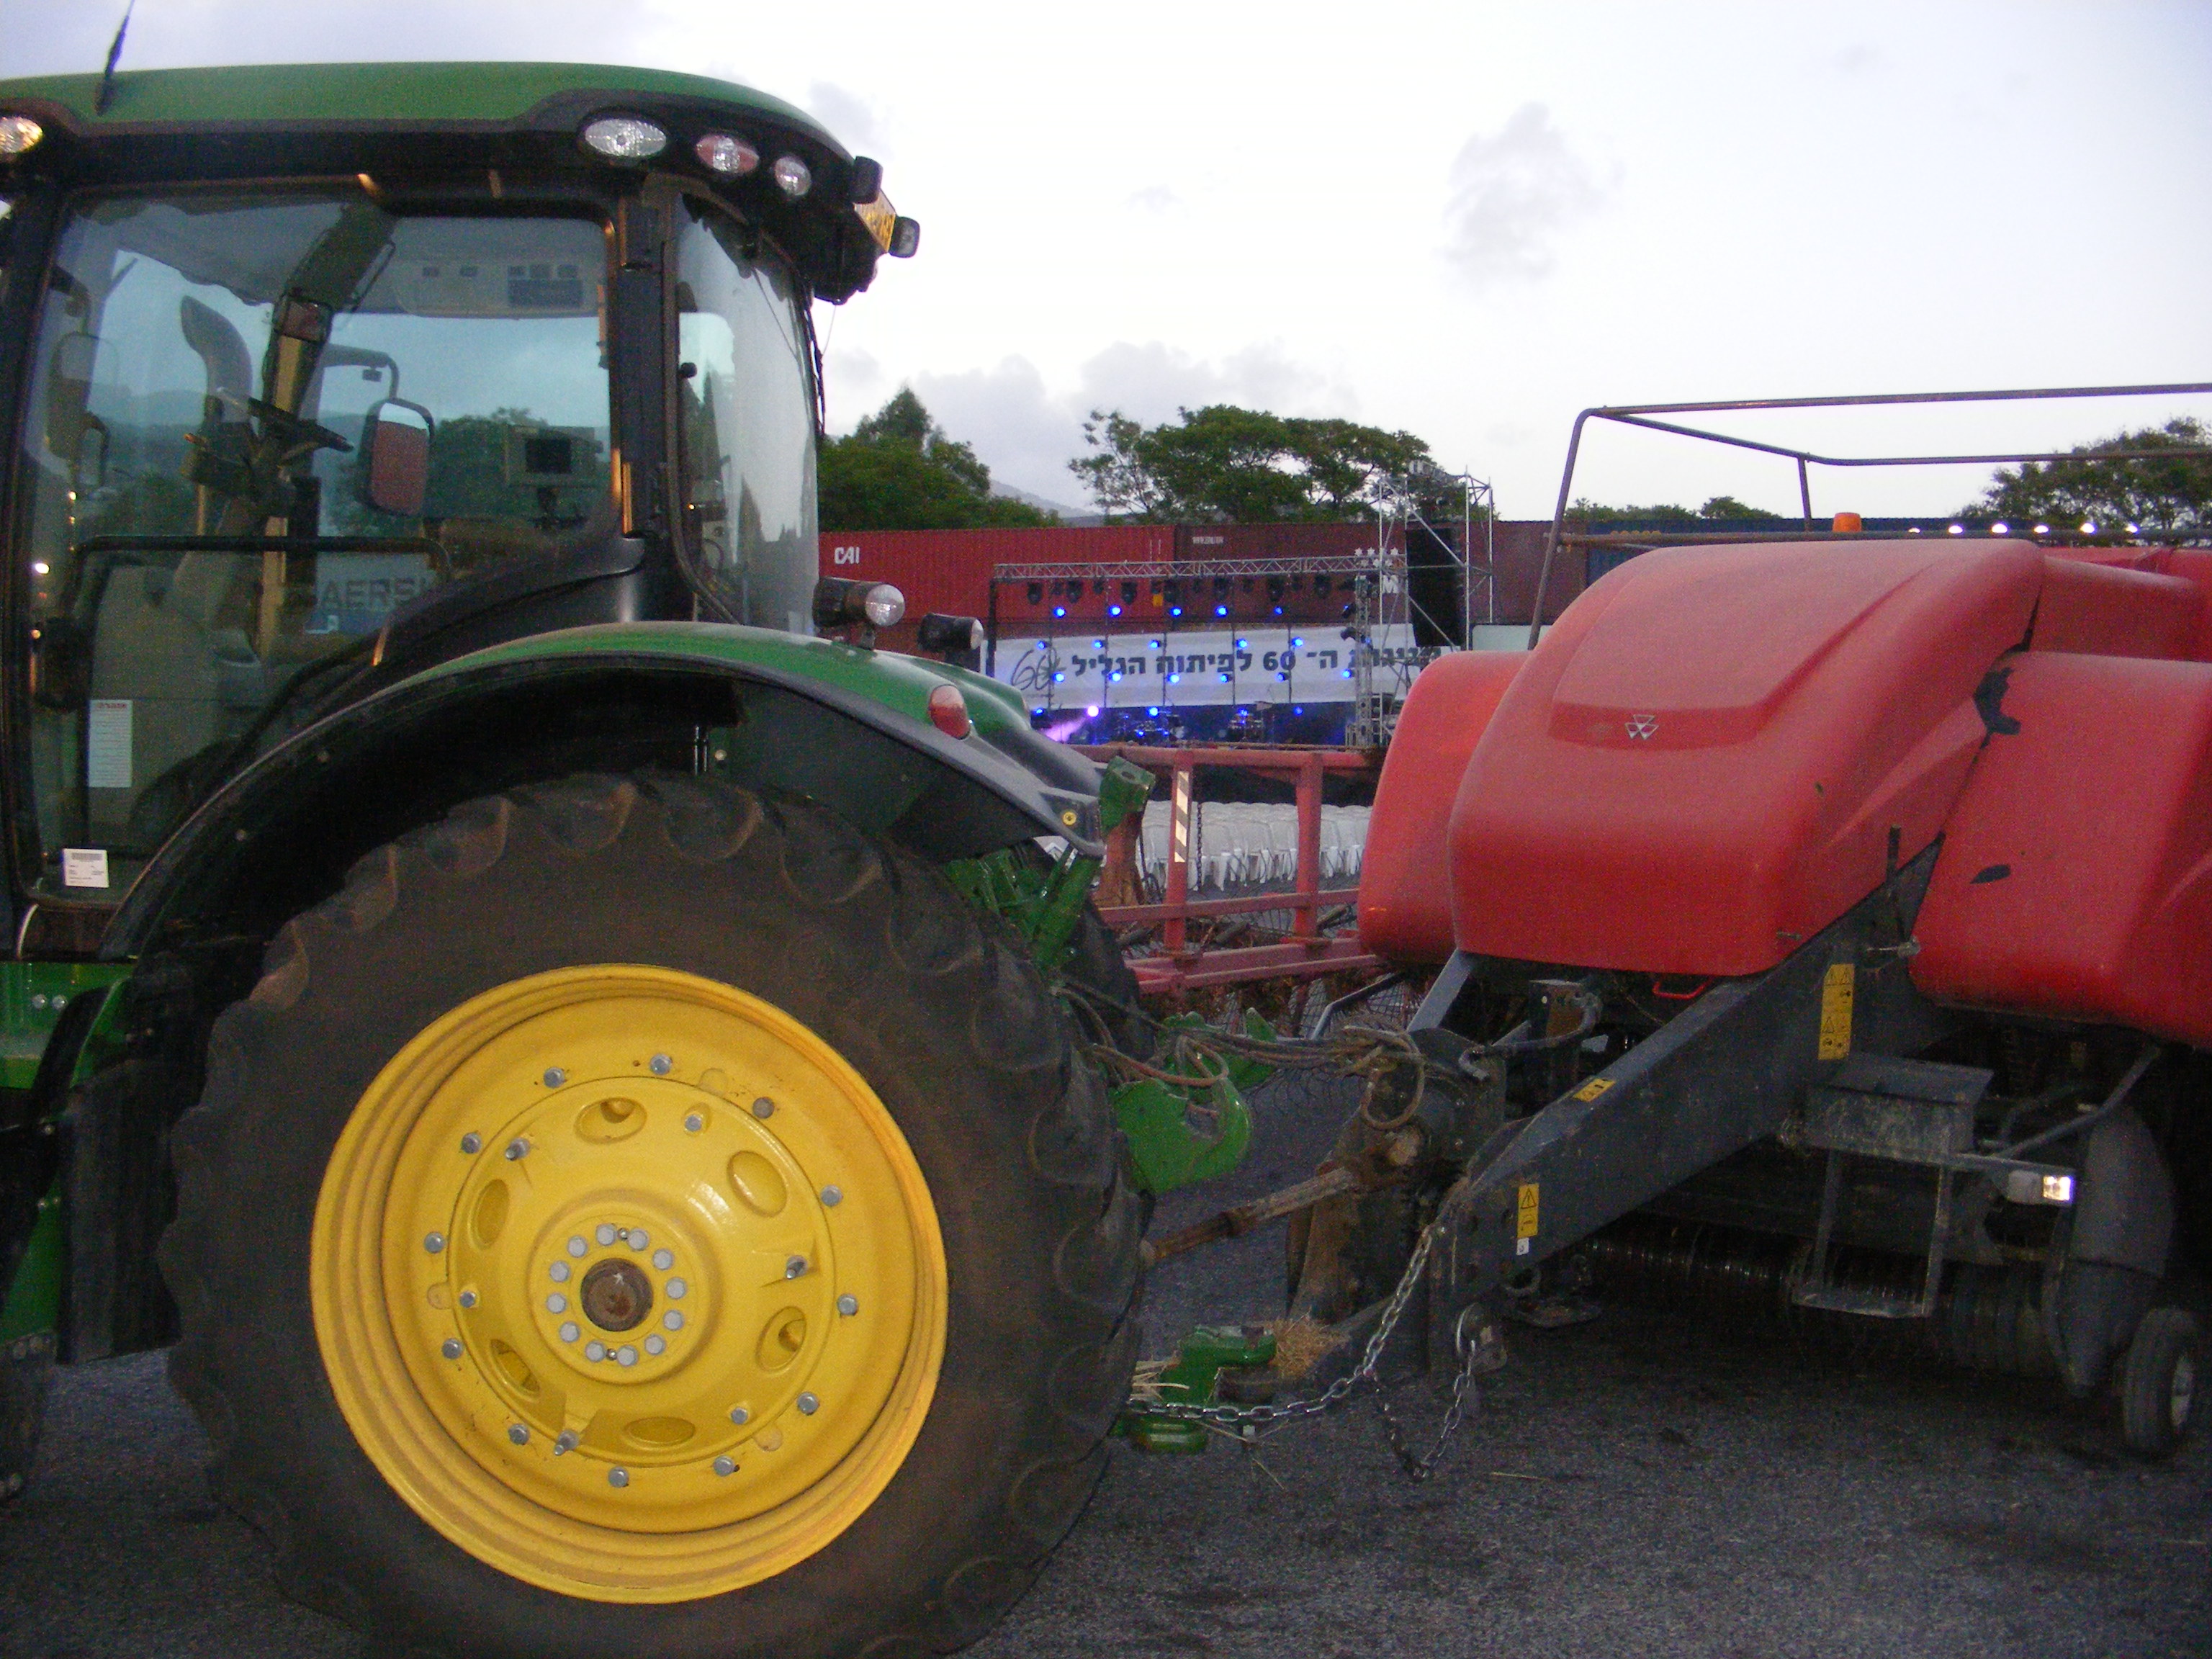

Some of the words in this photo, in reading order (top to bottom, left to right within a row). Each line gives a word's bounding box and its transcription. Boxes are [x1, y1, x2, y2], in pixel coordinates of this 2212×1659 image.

[835, 546, 860, 565] CAI
[1071, 654, 1146, 677] הגליל
[1156, 649, 1252, 674] לפיתוח
[1262, 651, 1296, 671] 60
